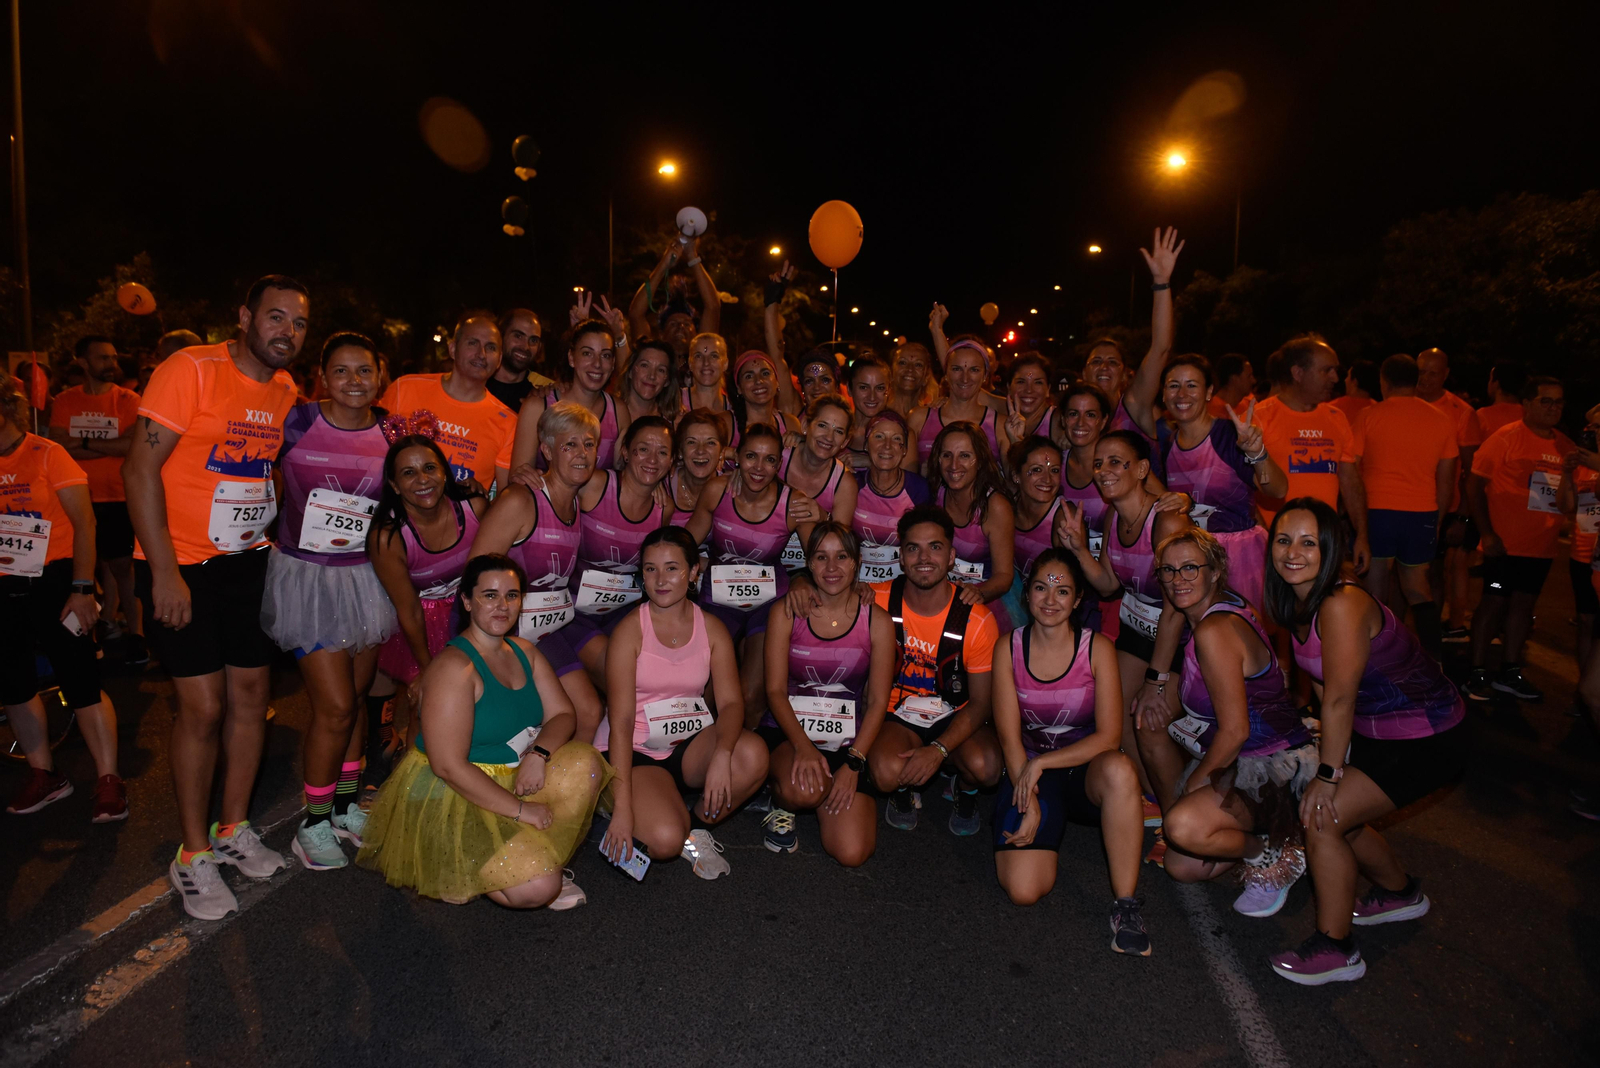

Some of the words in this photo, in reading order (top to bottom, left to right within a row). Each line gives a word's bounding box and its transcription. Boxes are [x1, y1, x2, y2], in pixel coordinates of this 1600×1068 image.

[245, 408, 273, 425] XXXV
[227, 420, 255, 430] CARRERA
[256, 425, 281, 433] NOCTURNA
[437, 420, 470, 438] XXXV
[79, 430, 109, 439] 17127
[231, 427, 280, 441] GUADALQUIVIR
[1298, 429, 1323, 438] XXXV
[436, 436, 477, 453] DALQUIVIR
[447, 434, 479, 447] NOCTURNA
[1540, 486, 1558, 497] 153
[233, 506, 267, 521] 7527
[1585, 506, 1600, 516] 153
[325, 512, 363, 532] 7528
[865, 566, 894, 579] 7524
[594, 591, 626, 604] 7546
[728, 585, 760, 597] 7559
[531, 611, 566, 628] 17974
[663, 718, 703, 736] 18903
[799, 718, 843, 734] 17588
